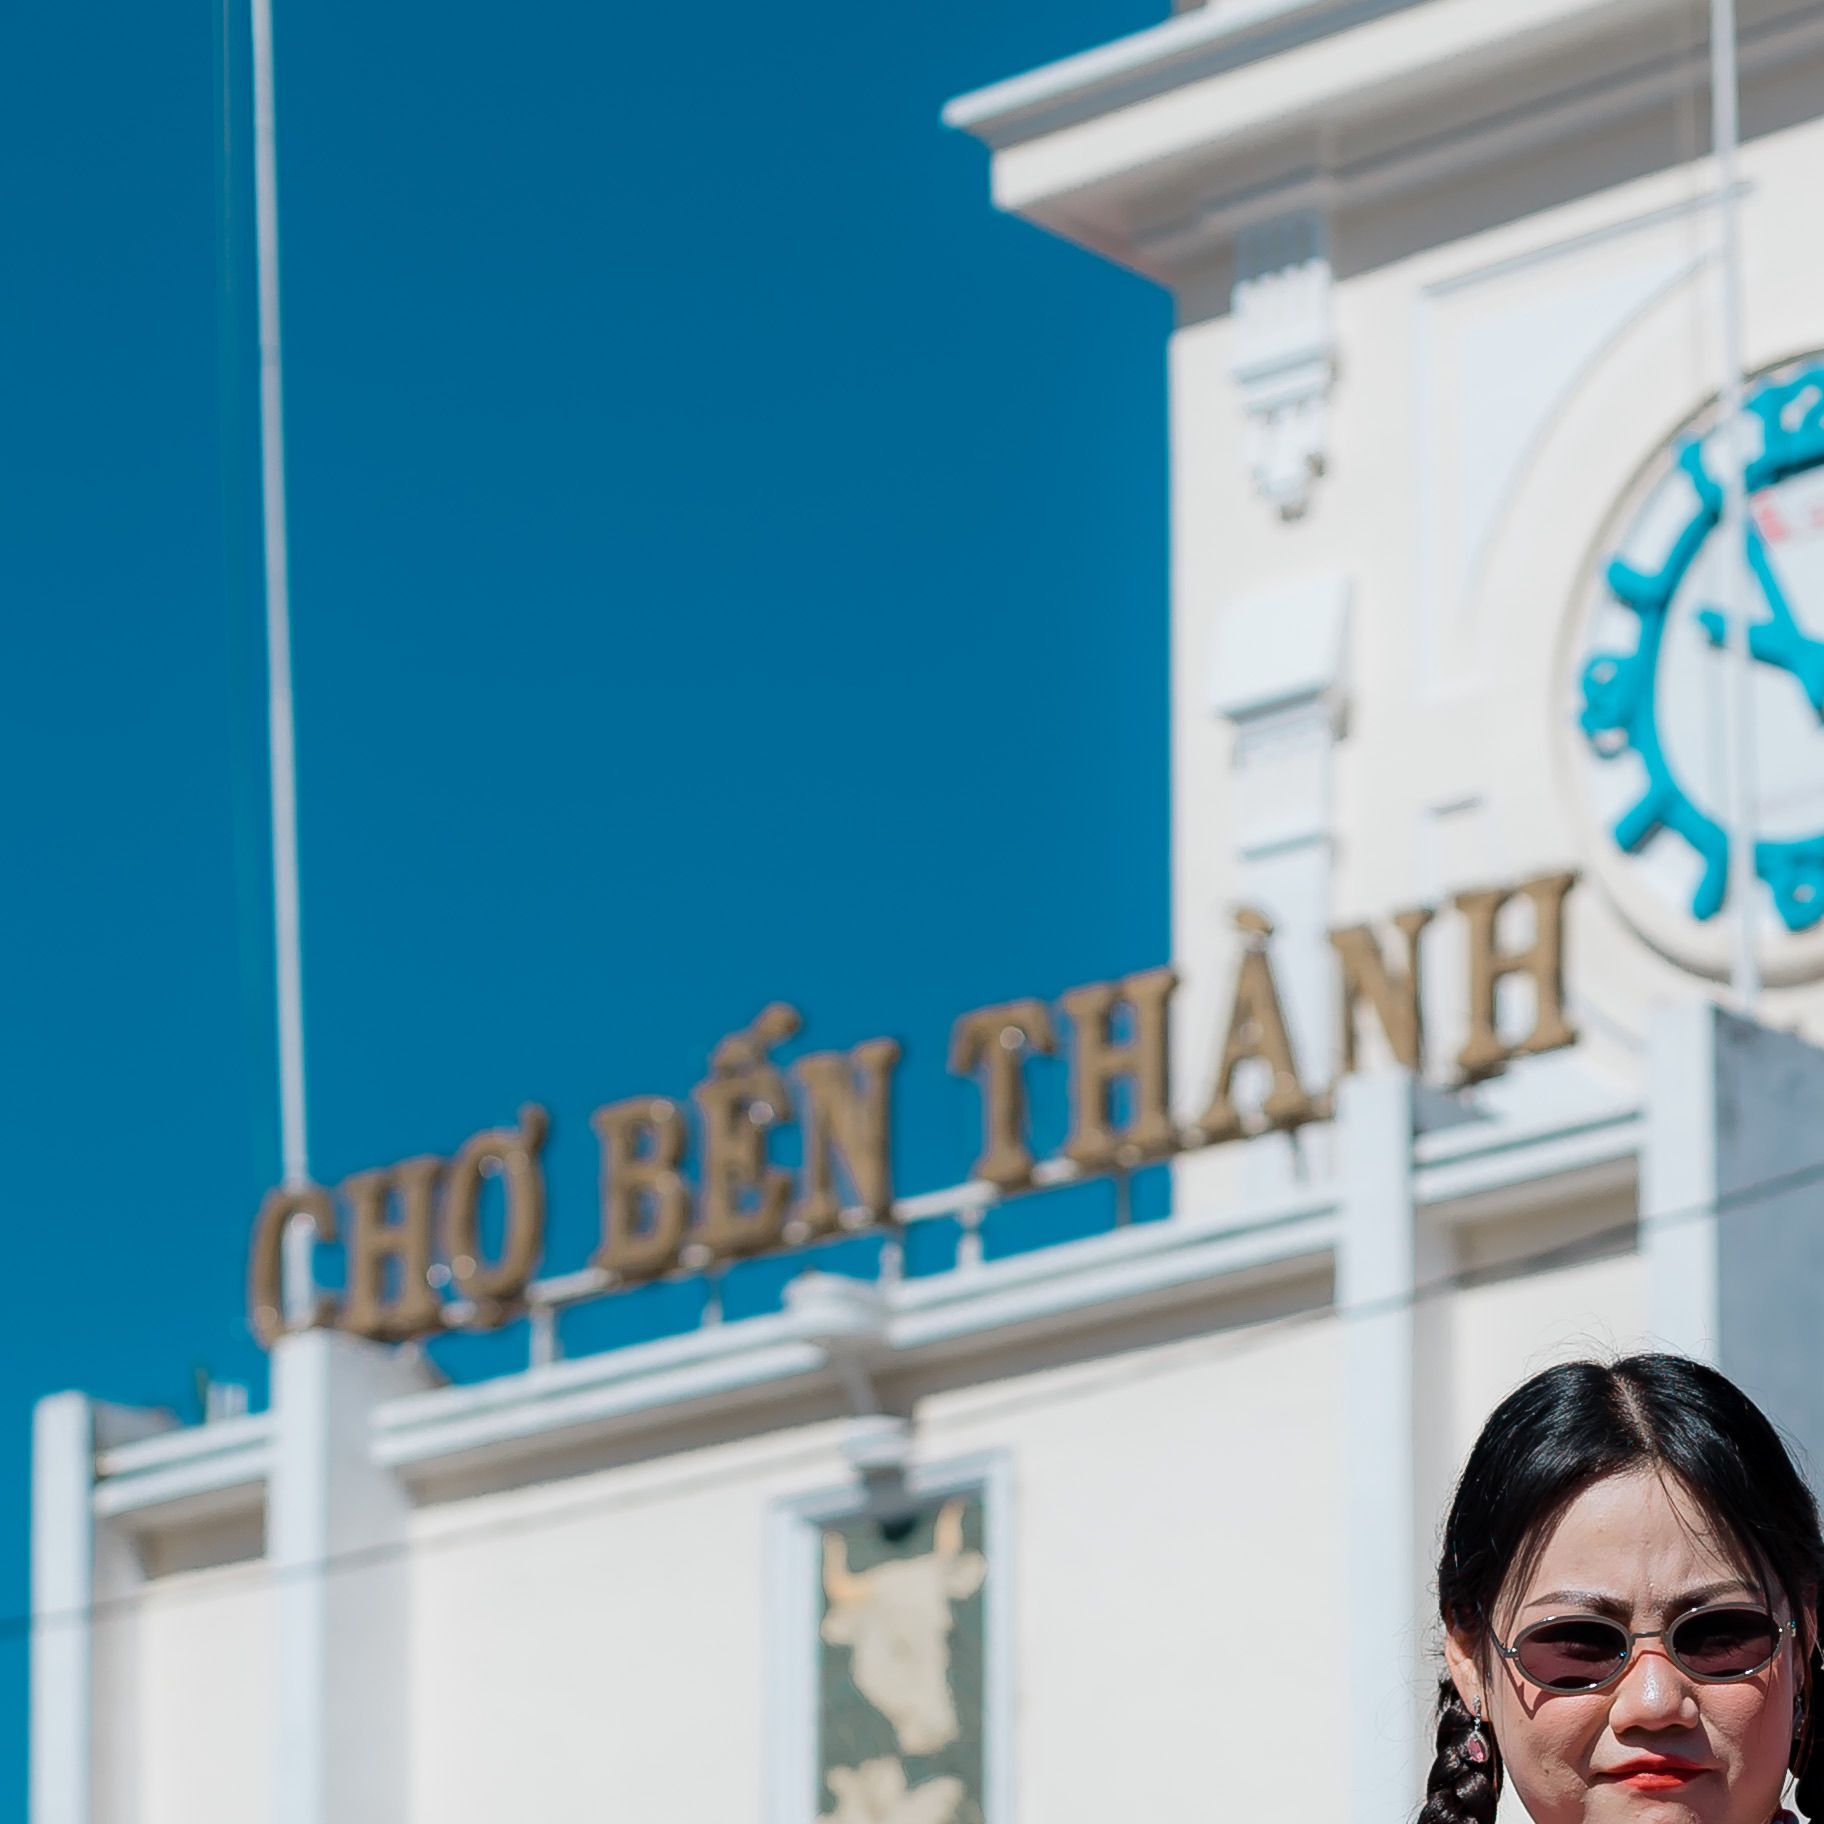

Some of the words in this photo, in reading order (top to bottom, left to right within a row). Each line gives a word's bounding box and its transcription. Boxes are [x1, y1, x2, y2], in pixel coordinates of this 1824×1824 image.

[252, 1104, 547, 1346] CHỢ
[592, 1004, 900, 1283] BẾN
[952, 872, 1577, 1190] THÀNH
